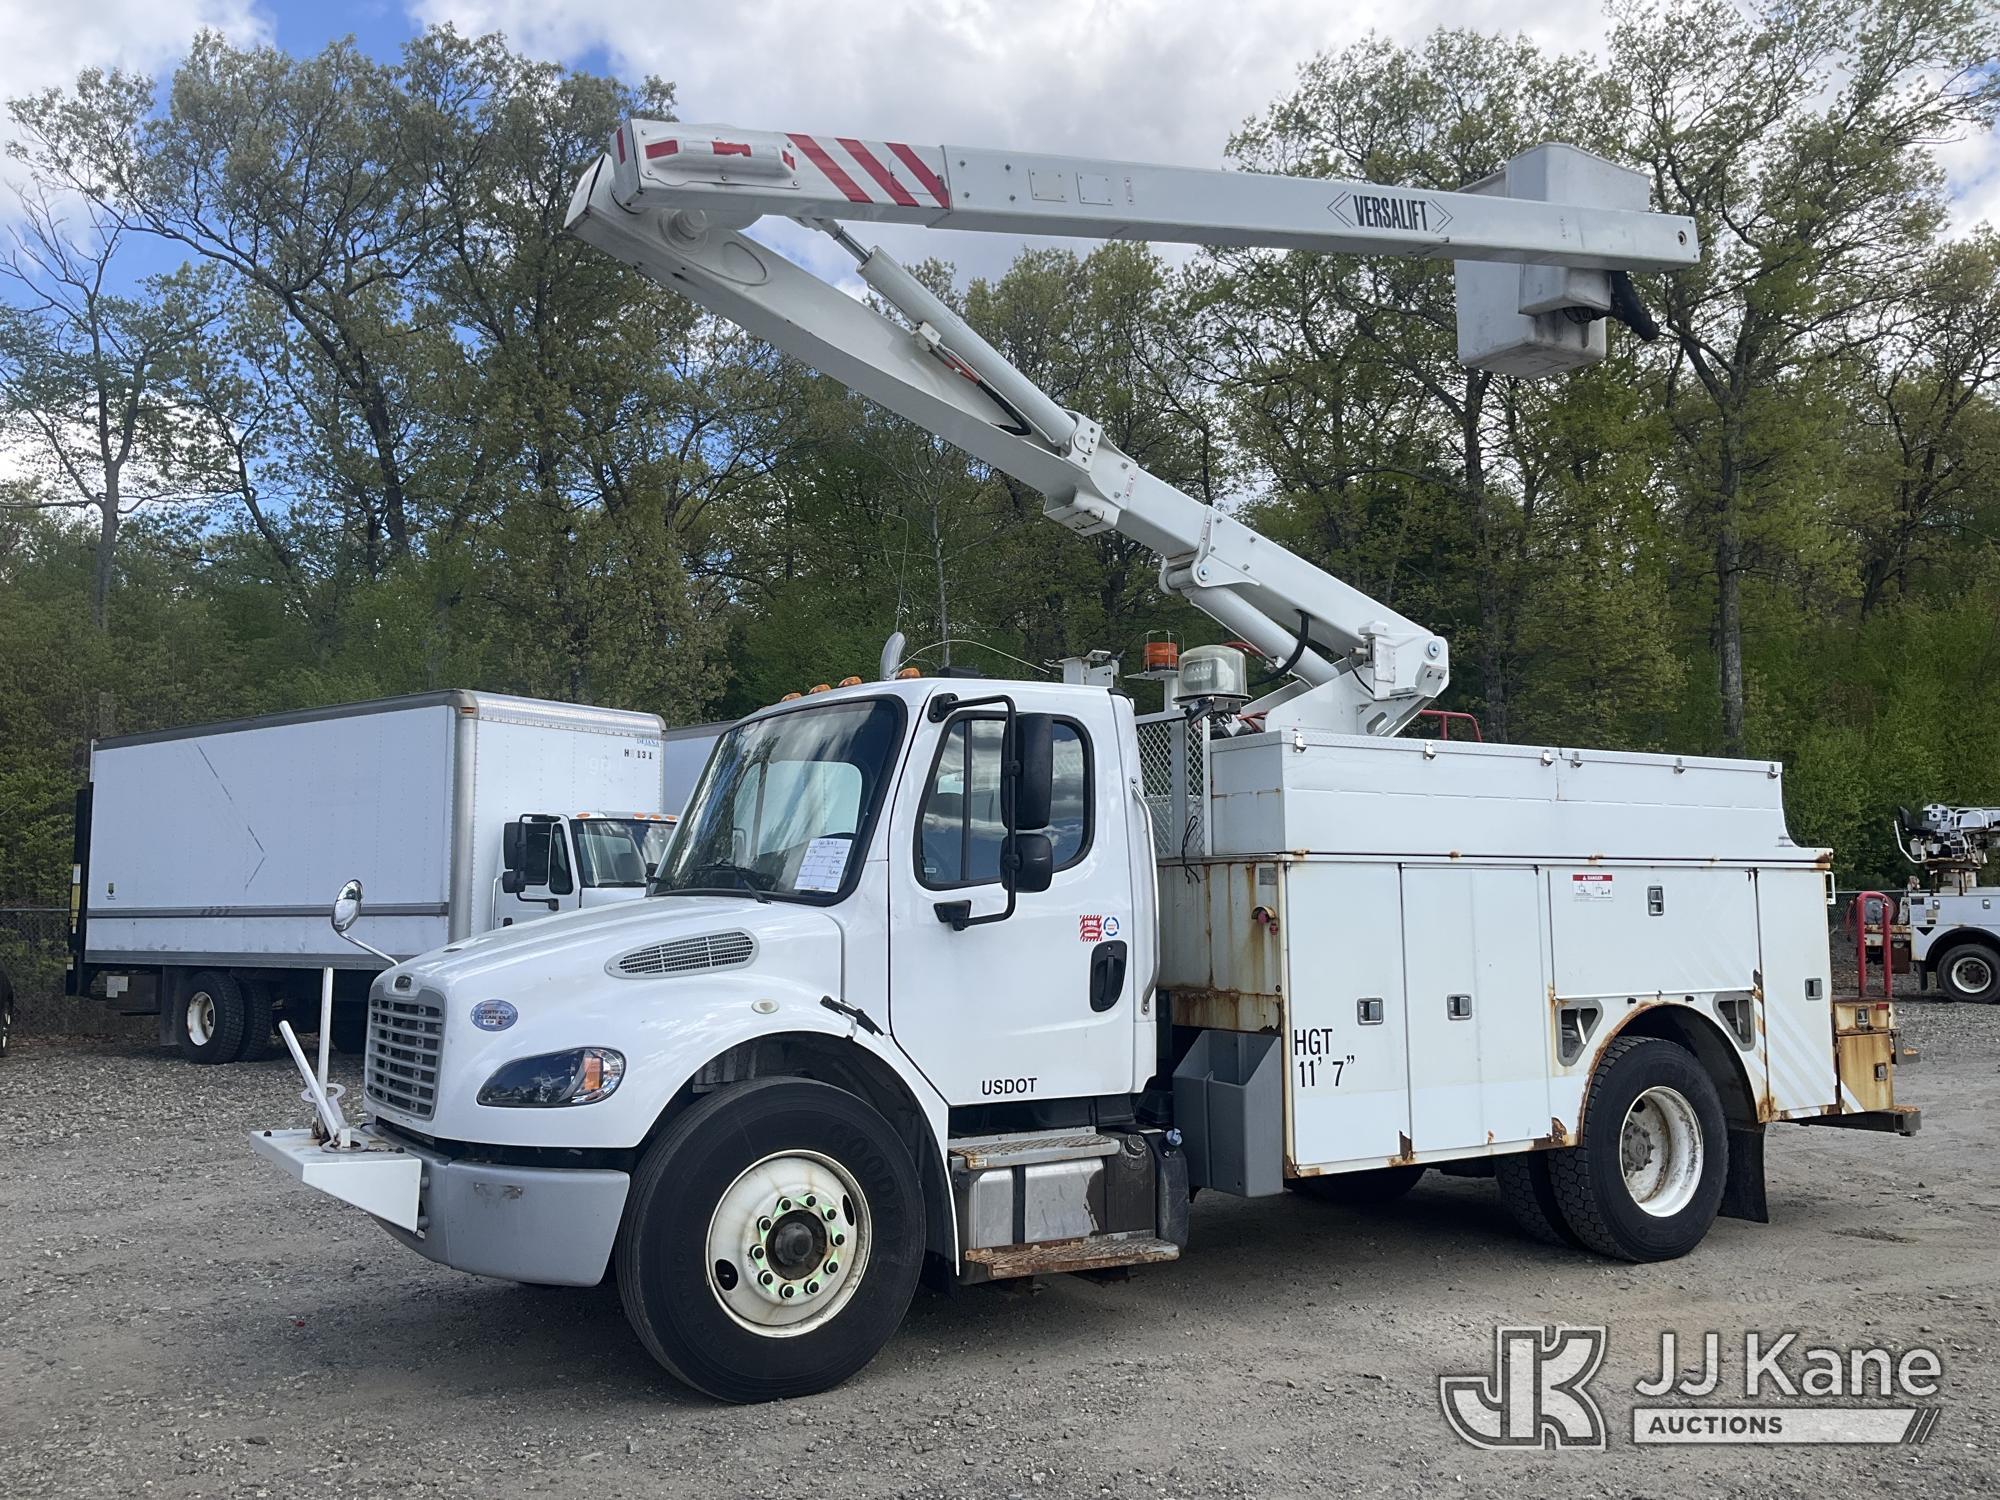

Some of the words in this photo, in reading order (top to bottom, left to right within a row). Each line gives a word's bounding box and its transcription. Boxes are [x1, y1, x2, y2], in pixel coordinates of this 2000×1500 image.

[1352, 194, 1428, 231] VERSALIFT
[1294, 1028, 1333, 1056] HGT
[982, 1077, 1038, 1096] USDOT
